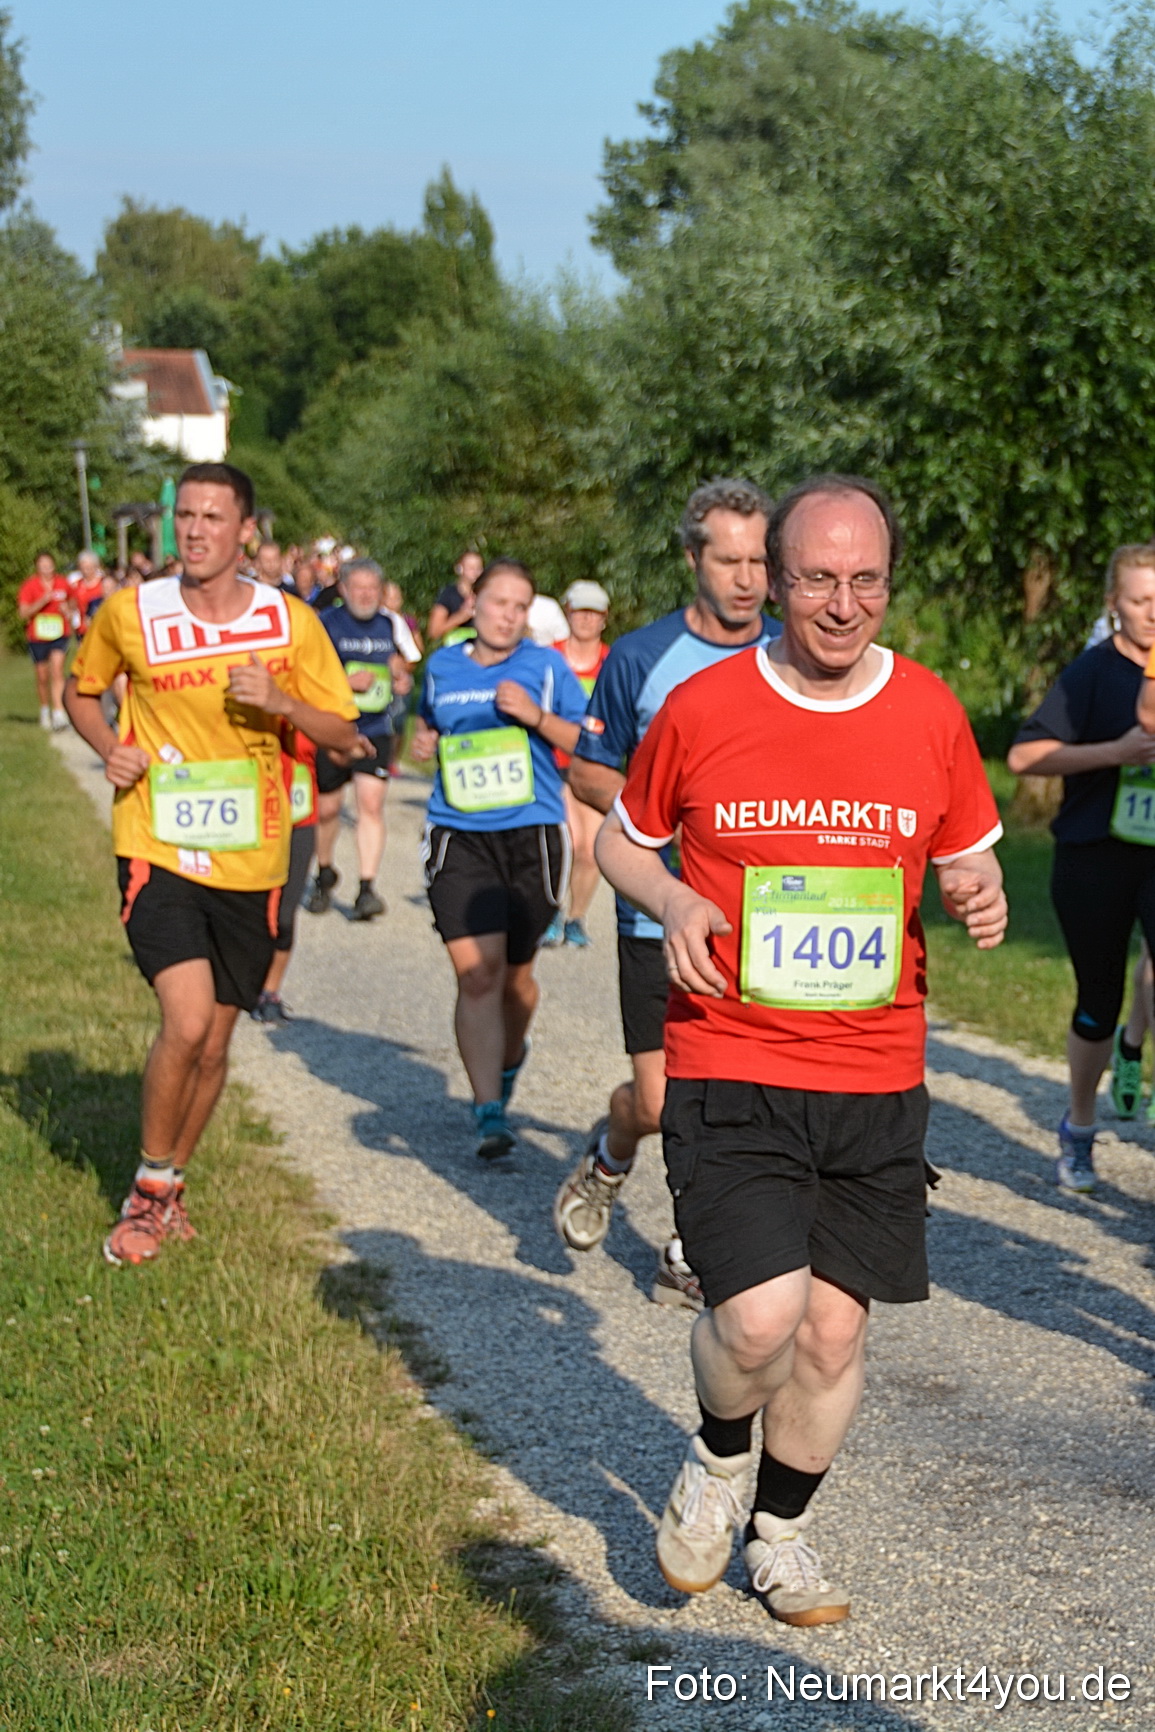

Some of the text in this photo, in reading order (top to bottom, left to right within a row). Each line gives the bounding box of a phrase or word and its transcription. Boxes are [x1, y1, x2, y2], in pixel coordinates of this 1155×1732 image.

[152, 667, 217, 693] MAX
[456, 761, 524, 790] 1315
[176, 798, 238, 828] 876
[715, 799, 892, 831] NEUMARKT
[1126, 792, 1155, 820] 11
[817, 835, 890, 849] STARKE STADT
[763, 925, 887, 969] 1404
[793, 981, 820, 989] Frank
